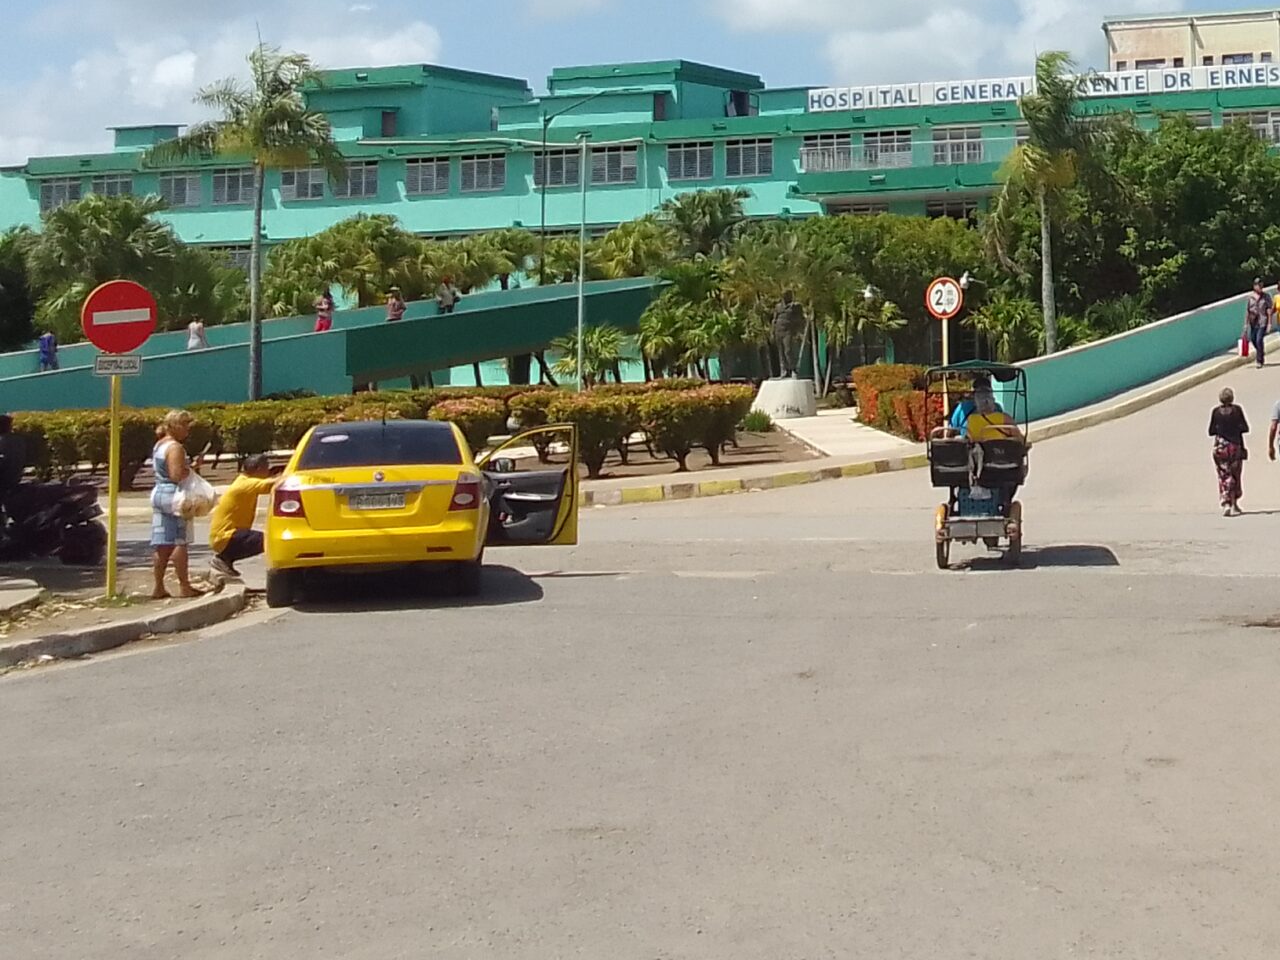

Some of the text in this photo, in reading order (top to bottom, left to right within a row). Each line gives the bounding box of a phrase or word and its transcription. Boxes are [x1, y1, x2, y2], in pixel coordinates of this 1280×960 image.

[810, 88, 919, 110] HOSPITAL
[935, 81, 1031, 103] GENERAL
[1164, 71, 1192, 89] DR
